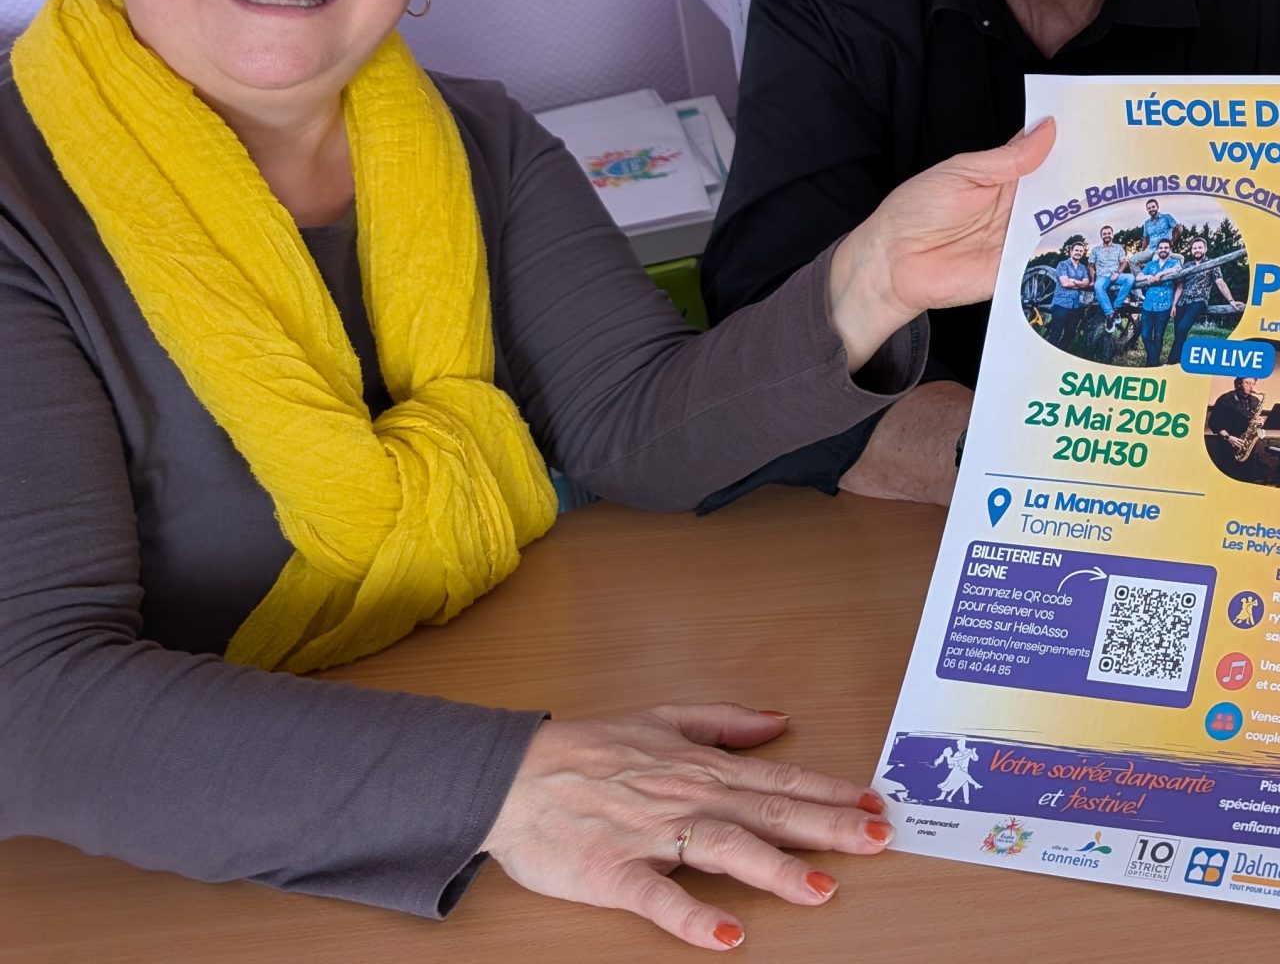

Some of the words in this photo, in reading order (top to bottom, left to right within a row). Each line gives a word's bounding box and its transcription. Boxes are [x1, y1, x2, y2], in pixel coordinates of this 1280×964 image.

[1125, 92, 1247, 127] L'ÉCOLE
[1034, 199, 1081, 231] Des
[1085, 175, 1179, 207] Balkans
[1186, 174, 1231, 194] aux
[1189, 347, 1215, 364] EN
[1221, 349, 1264, 369] LIVE
[1059, 372, 1166, 403] SAMEDI
[1025, 401, 1060, 426] 23
[1065, 404, 1113, 431] Mai
[1116, 409, 1190, 438] 2026
[1053, 436, 1148, 467] 20H30
[1024, 489, 1049, 508] La
[1055, 492, 1160, 524] Manoque
[1021, 514, 1112, 541] Tonneins
[1222, 538, 1243, 550] Les
[972, 545, 1041, 564] BILLETERIE
[1042, 553, 1062, 567] EN
[967, 562, 1008, 579] LIGNE
[963, 583, 1011, 598] Scannez
[1012, 588, 1022, 599] le
[1024, 590, 1041, 602] QR
[1042, 594, 1072, 605] code
[958, 600, 986, 612] pour
[987, 602, 1033, 617] réserver
[1034, 610, 1054, 620] vos
[954, 615, 992, 629] places
[994, 621, 1014, 631] sur
[1014, 621, 1068, 638] HelloAsso
[946, 646, 964, 656] par
[966, 648, 1015, 662] téléphone
[1016, 655, 1030, 664] au
[950, 632, 1090, 657] Réservation/renseignements
[943, 658, 955, 668] 06
[958, 660, 967, 669] 61
[969, 662, 982, 671] 40
[983, 664, 996, 673] 44
[998, 665, 1011, 675] 85
[1256, 680, 1268, 690] et
[990, 749, 1045, 775] Votre
[1048, 758, 1111, 782] soirée
[1115, 761, 1216, 794] dansante
[1038, 790, 1064, 807] et
[1060, 787, 1146, 814] festive!
[916, 818, 959, 828] partenariat
[1042, 850, 1099, 868] tonneins
[1138, 839, 1174, 863] 10
[1128, 870, 1167, 880] OPTICIENS
[1130, 861, 1170, 874] STRICT
[1245, 886, 1262, 894] POUR
